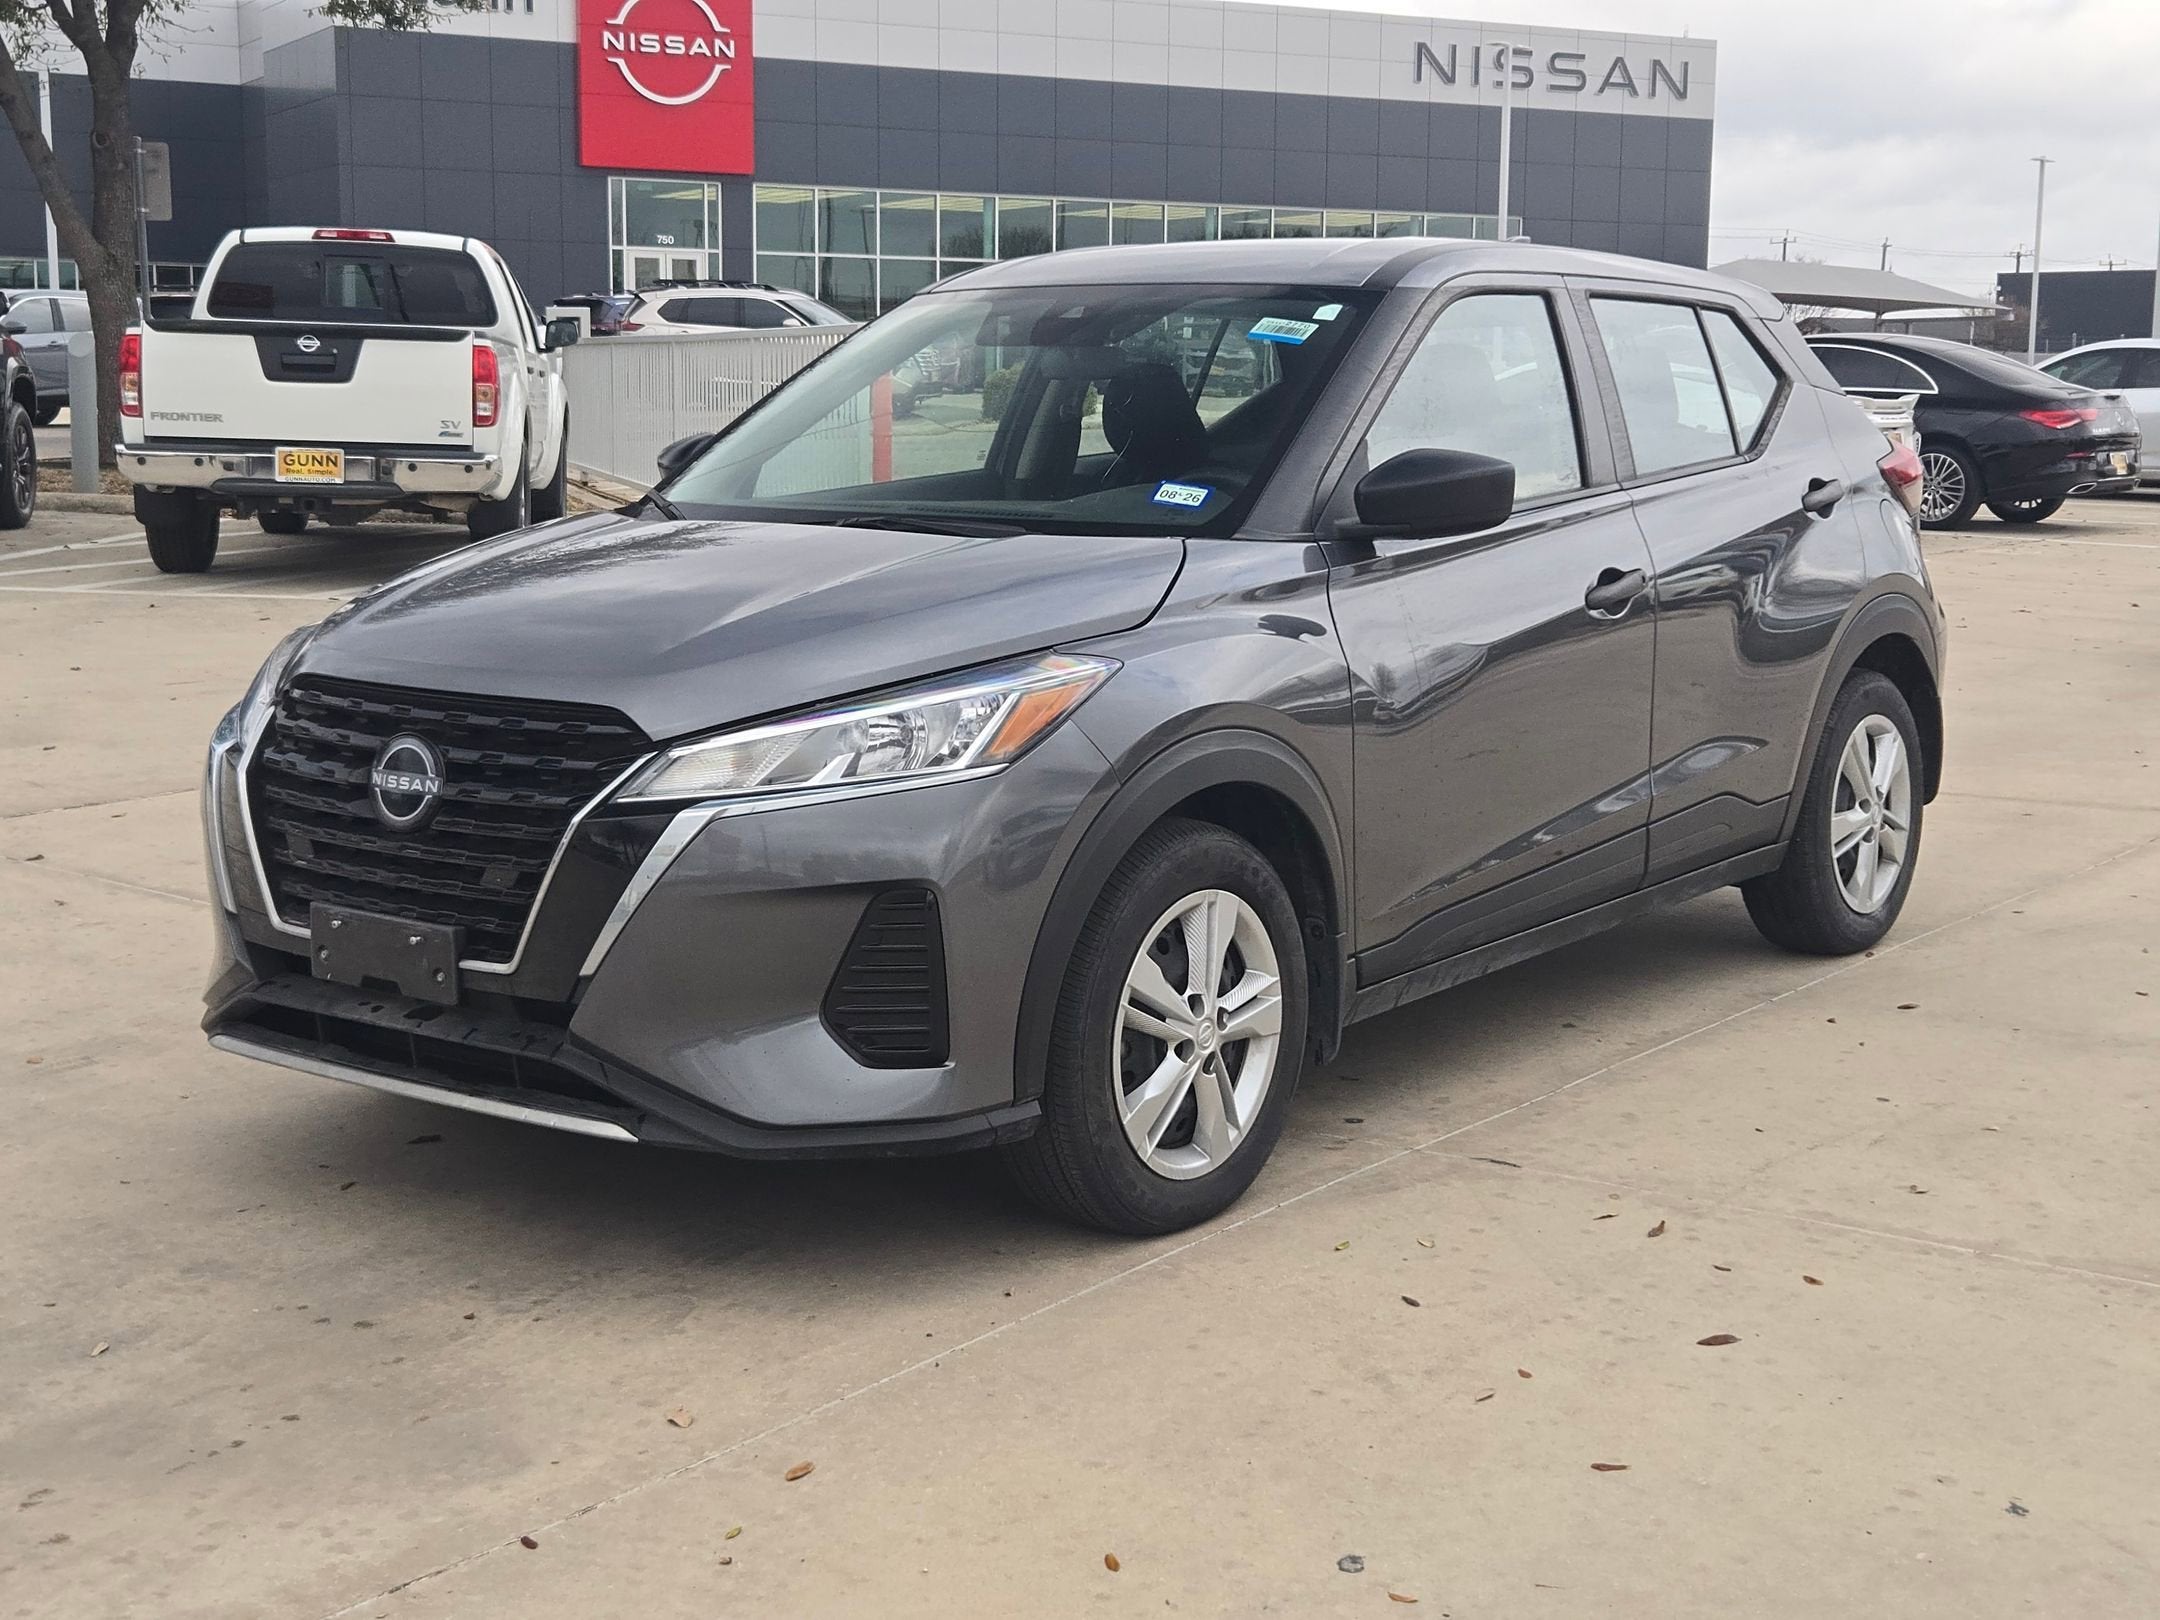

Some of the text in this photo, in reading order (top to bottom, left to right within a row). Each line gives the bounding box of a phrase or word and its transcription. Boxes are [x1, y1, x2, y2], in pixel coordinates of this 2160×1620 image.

[603, 30, 735, 59] NISSAN
[1413, 41, 1690, 100] NISSAN
[656, 234, 675, 245] 750
[150, 411, 224, 423] FRONTIER
[440, 420, 461, 430] SV
[283, 453, 338, 468] GUNN
[372, 771, 439, 793] NISSAN
